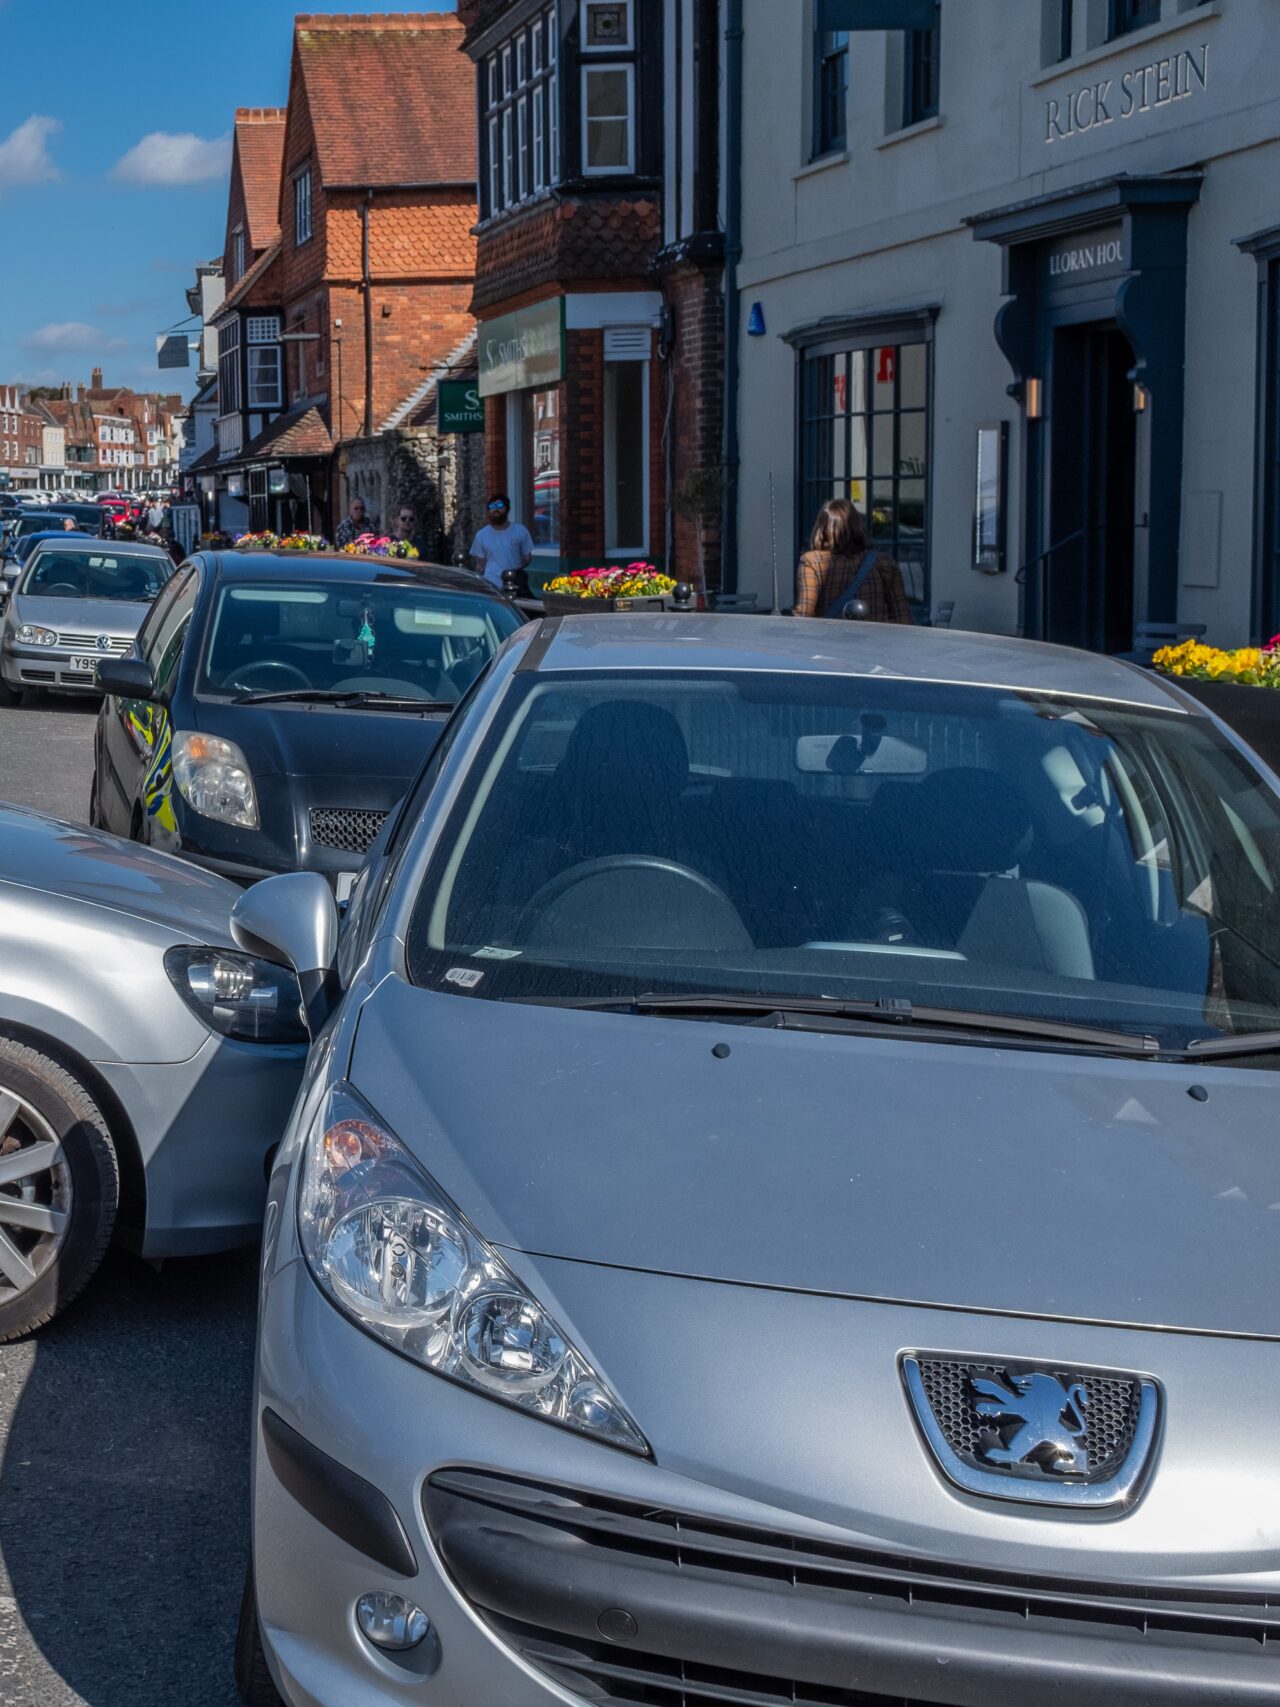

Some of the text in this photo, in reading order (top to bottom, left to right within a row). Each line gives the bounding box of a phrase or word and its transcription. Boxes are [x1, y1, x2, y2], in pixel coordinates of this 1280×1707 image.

[1045, 43, 1210, 143] RICK STEIN
[1049, 247, 1095, 275] LLORAN
[498, 335, 528, 365] SMITHS
[443, 412, 483, 422] SMITHS
